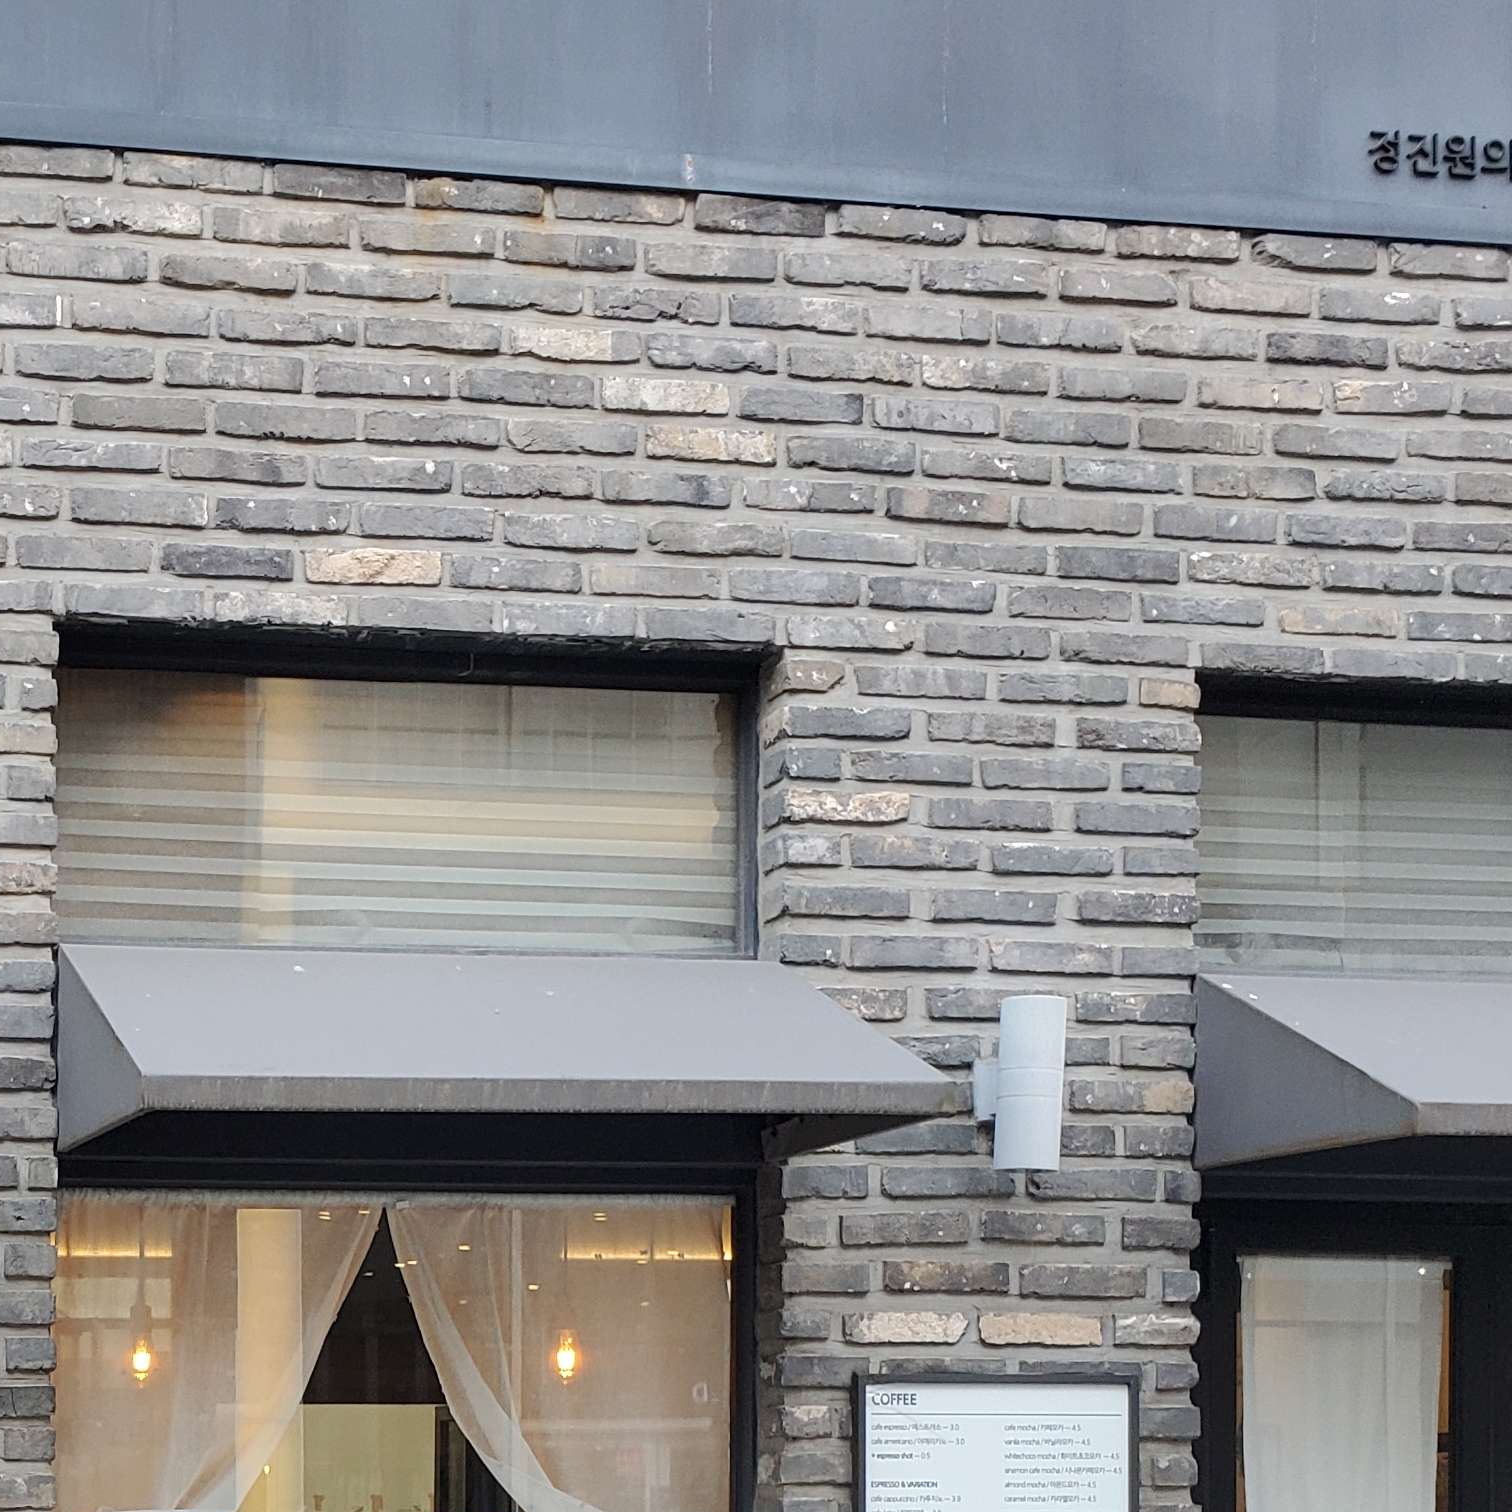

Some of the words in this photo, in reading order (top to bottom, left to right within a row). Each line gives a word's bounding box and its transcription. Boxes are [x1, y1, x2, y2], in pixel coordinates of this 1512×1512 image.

[1367, 129, 1512, 184] 정진원의
[871, 1393, 917, 1406] COFFEE
[1087, 1481, 1096, 1489] 4.5
[1087, 1495, 1096, 1503] 4.5
